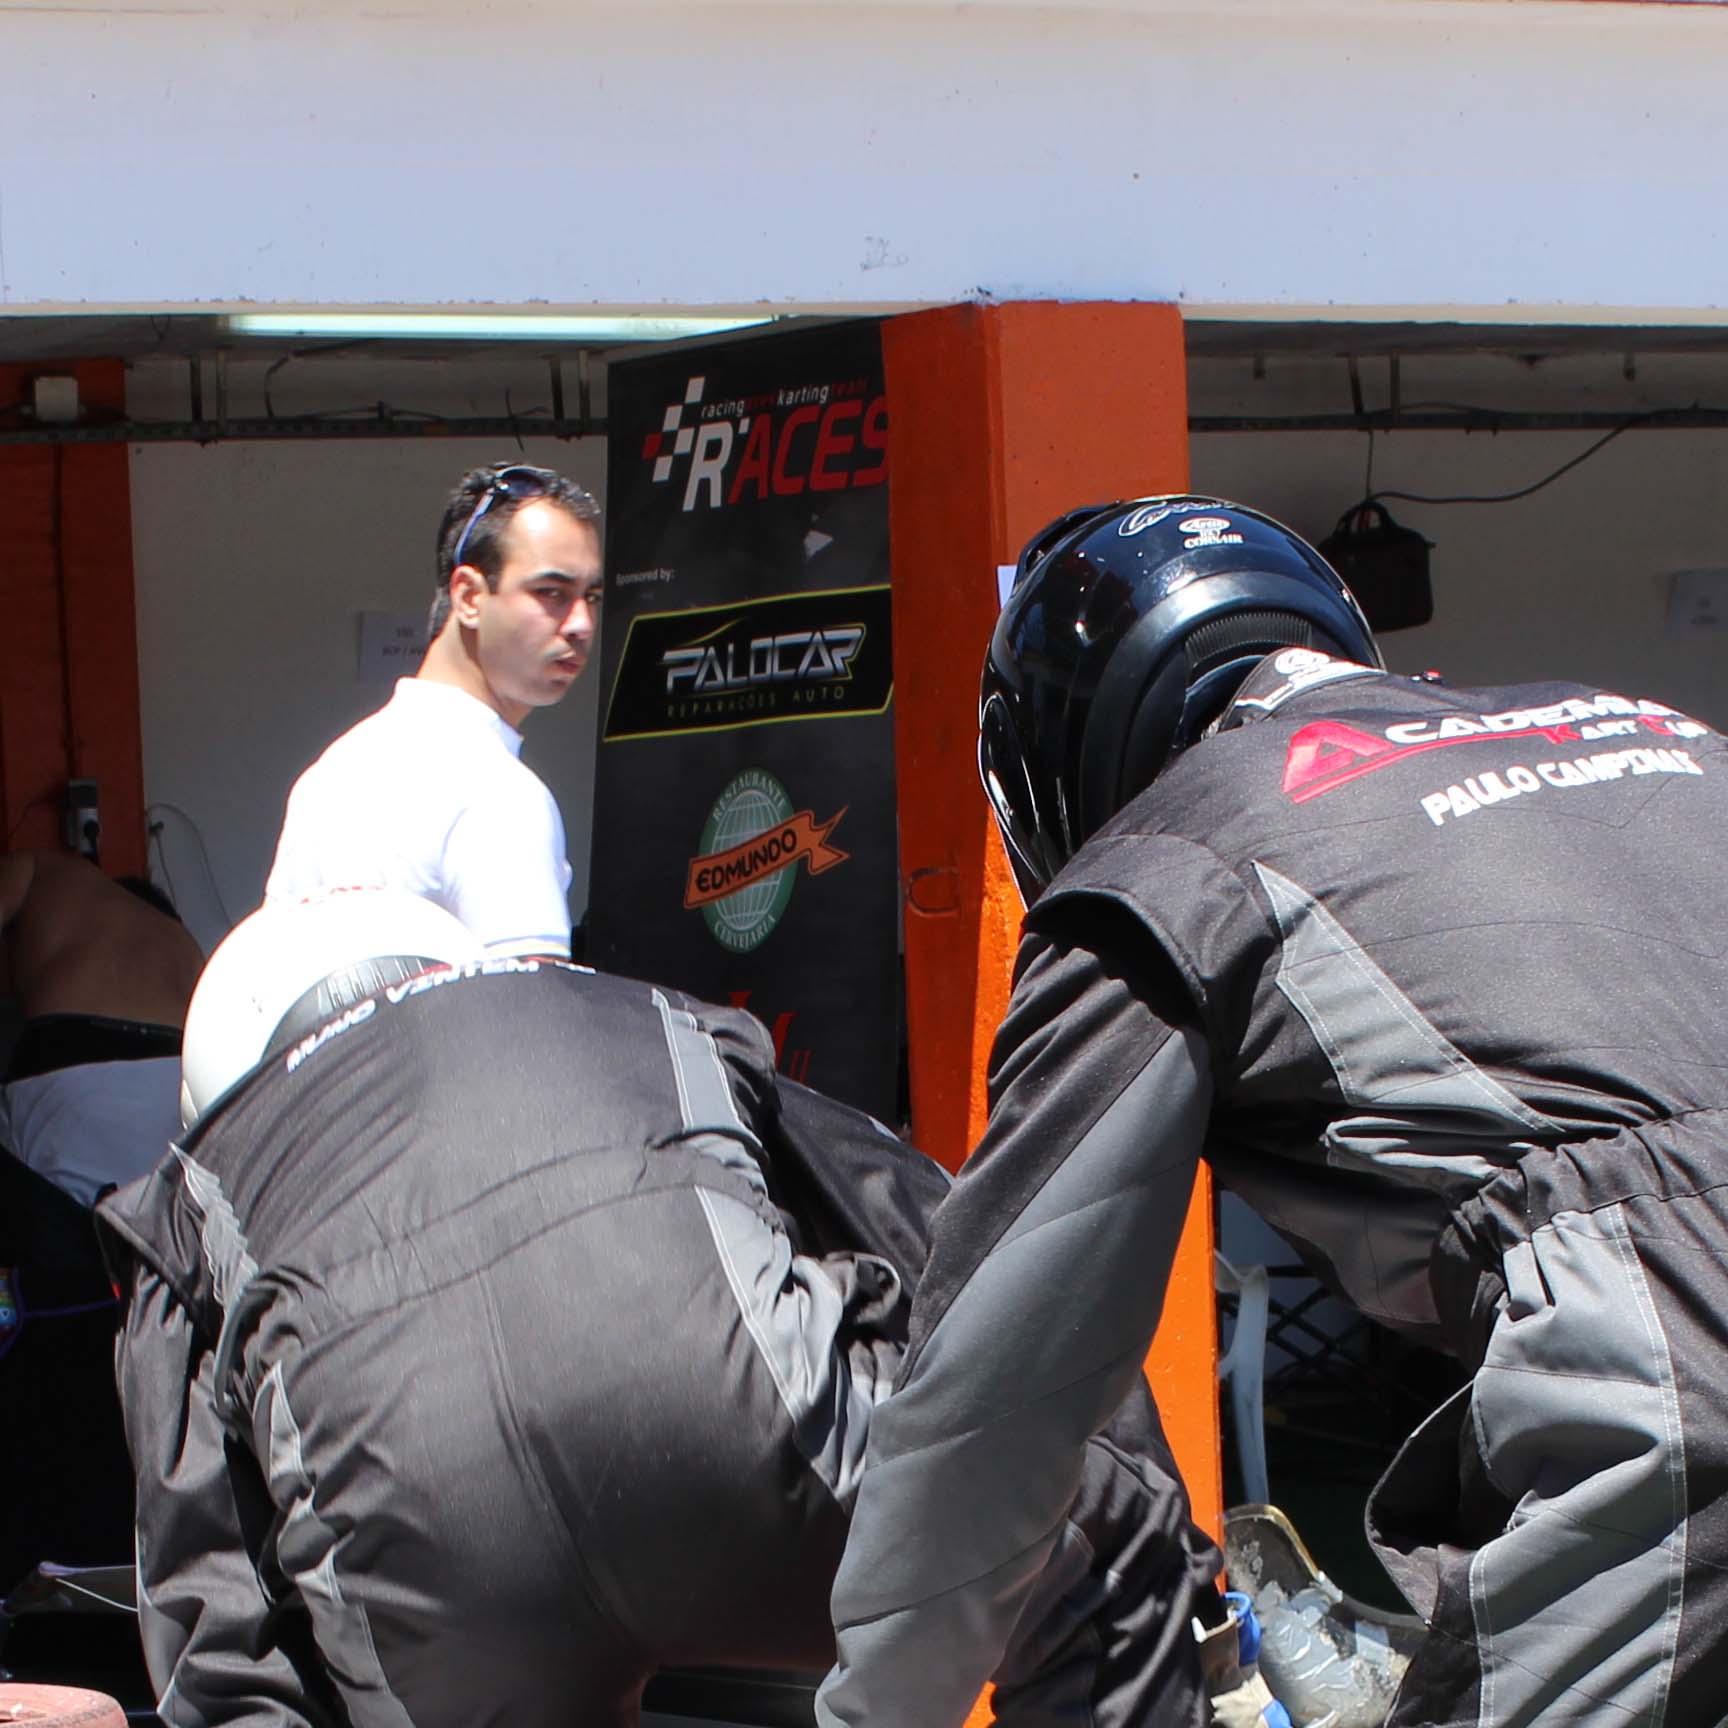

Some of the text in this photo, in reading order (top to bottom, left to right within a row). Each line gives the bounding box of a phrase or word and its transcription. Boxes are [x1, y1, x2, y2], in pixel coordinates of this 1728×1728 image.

[701, 398, 745, 418] racing
[777, 383, 830, 406] karting
[682, 395, 890, 512] RACES
[1420, 763, 1539, 826] PAULO
[696, 829, 797, 892] EDMUNDO
